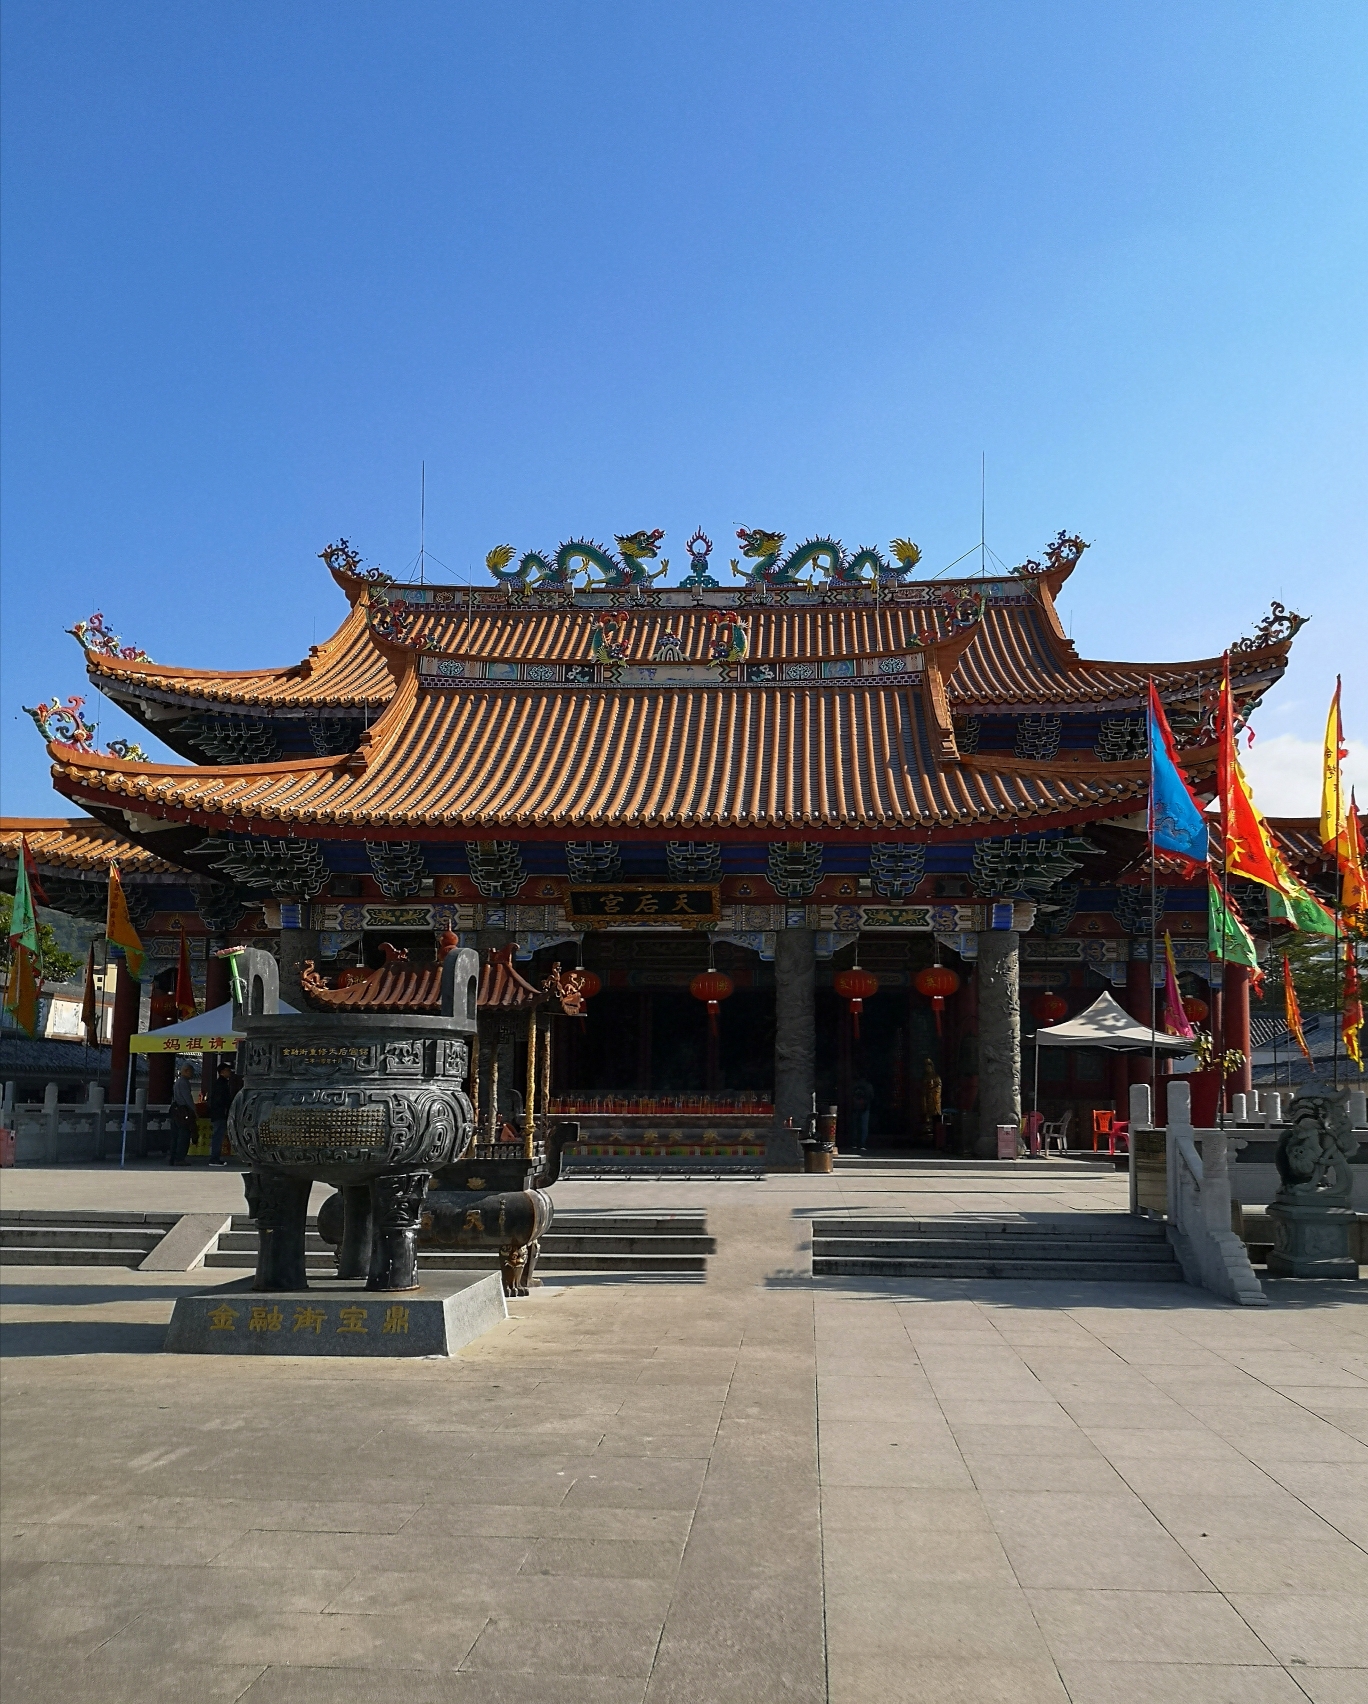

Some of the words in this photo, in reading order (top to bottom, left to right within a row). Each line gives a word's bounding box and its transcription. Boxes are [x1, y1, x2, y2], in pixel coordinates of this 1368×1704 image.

[599, 893, 697, 913] 天后宫
[207, 1303, 410, 1334] 金融街宝鼎
